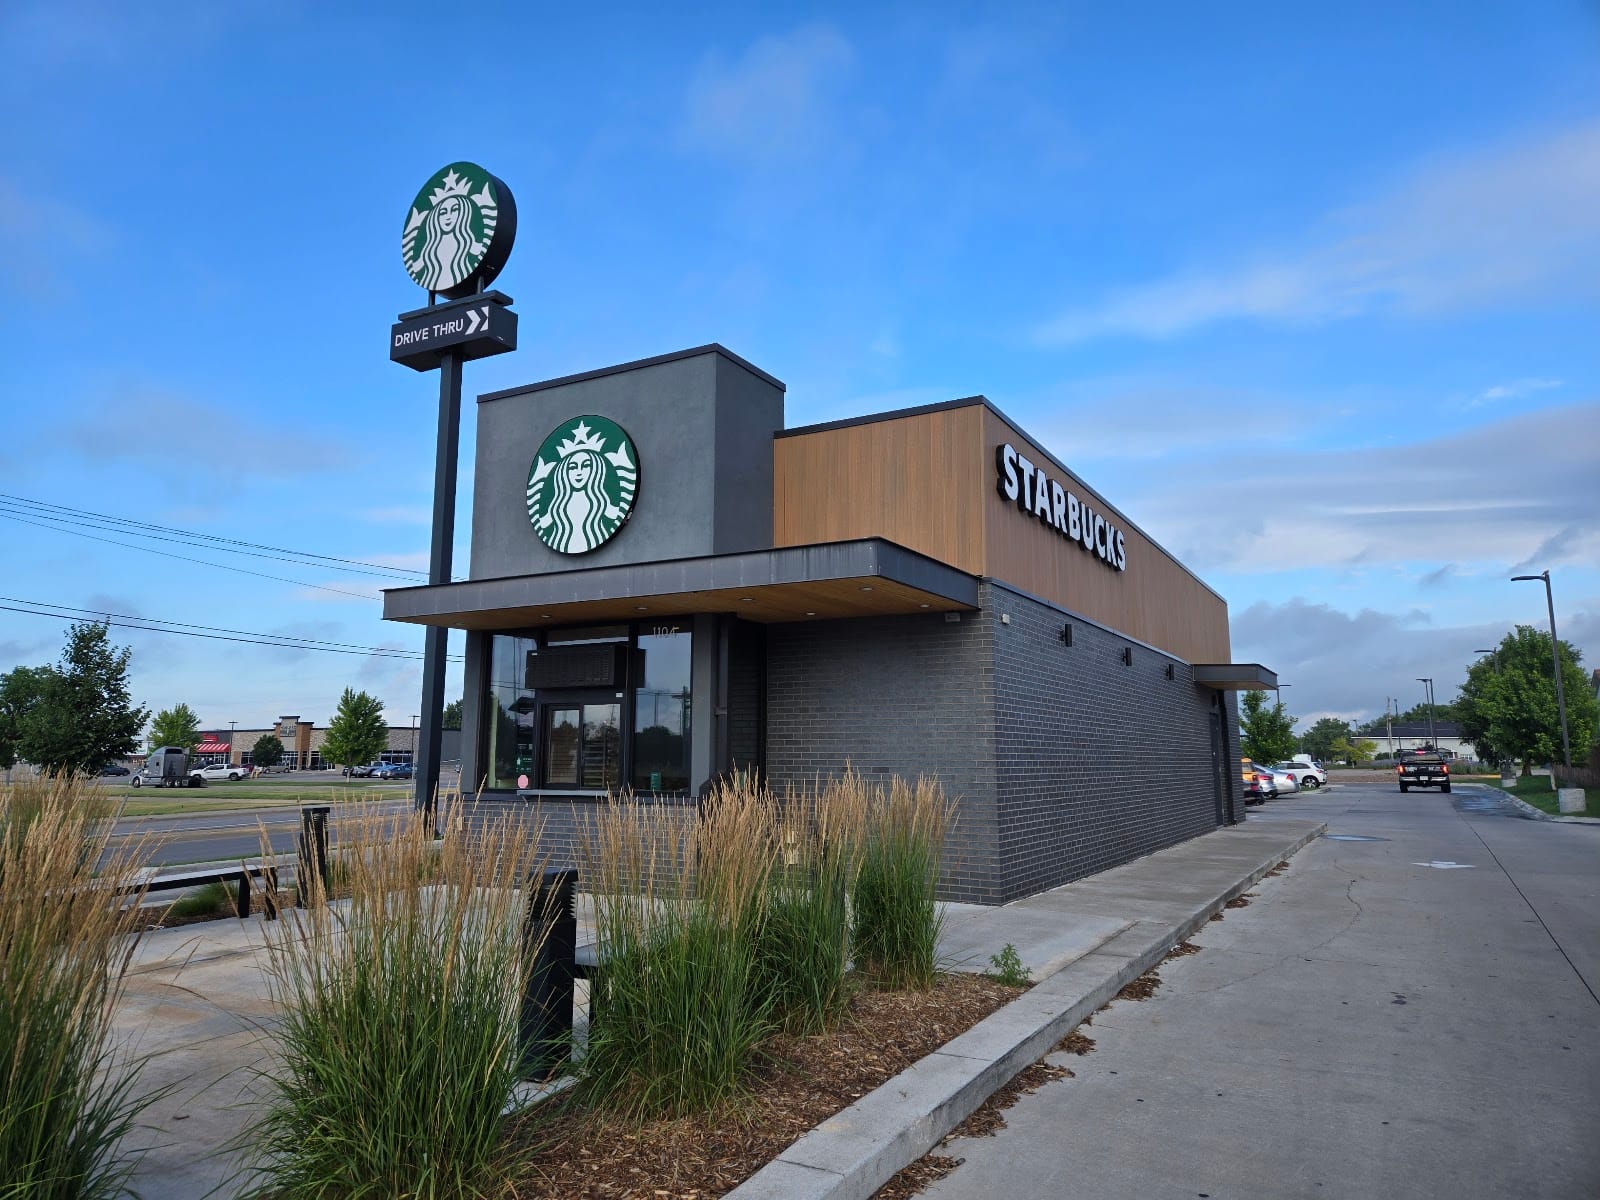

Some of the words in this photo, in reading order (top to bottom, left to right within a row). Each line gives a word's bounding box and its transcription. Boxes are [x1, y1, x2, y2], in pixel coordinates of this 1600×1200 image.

[394, 327, 429, 347] DRIVE
[432, 318, 464, 337] THRU
[1002, 443, 1127, 572] STARBUCKS
